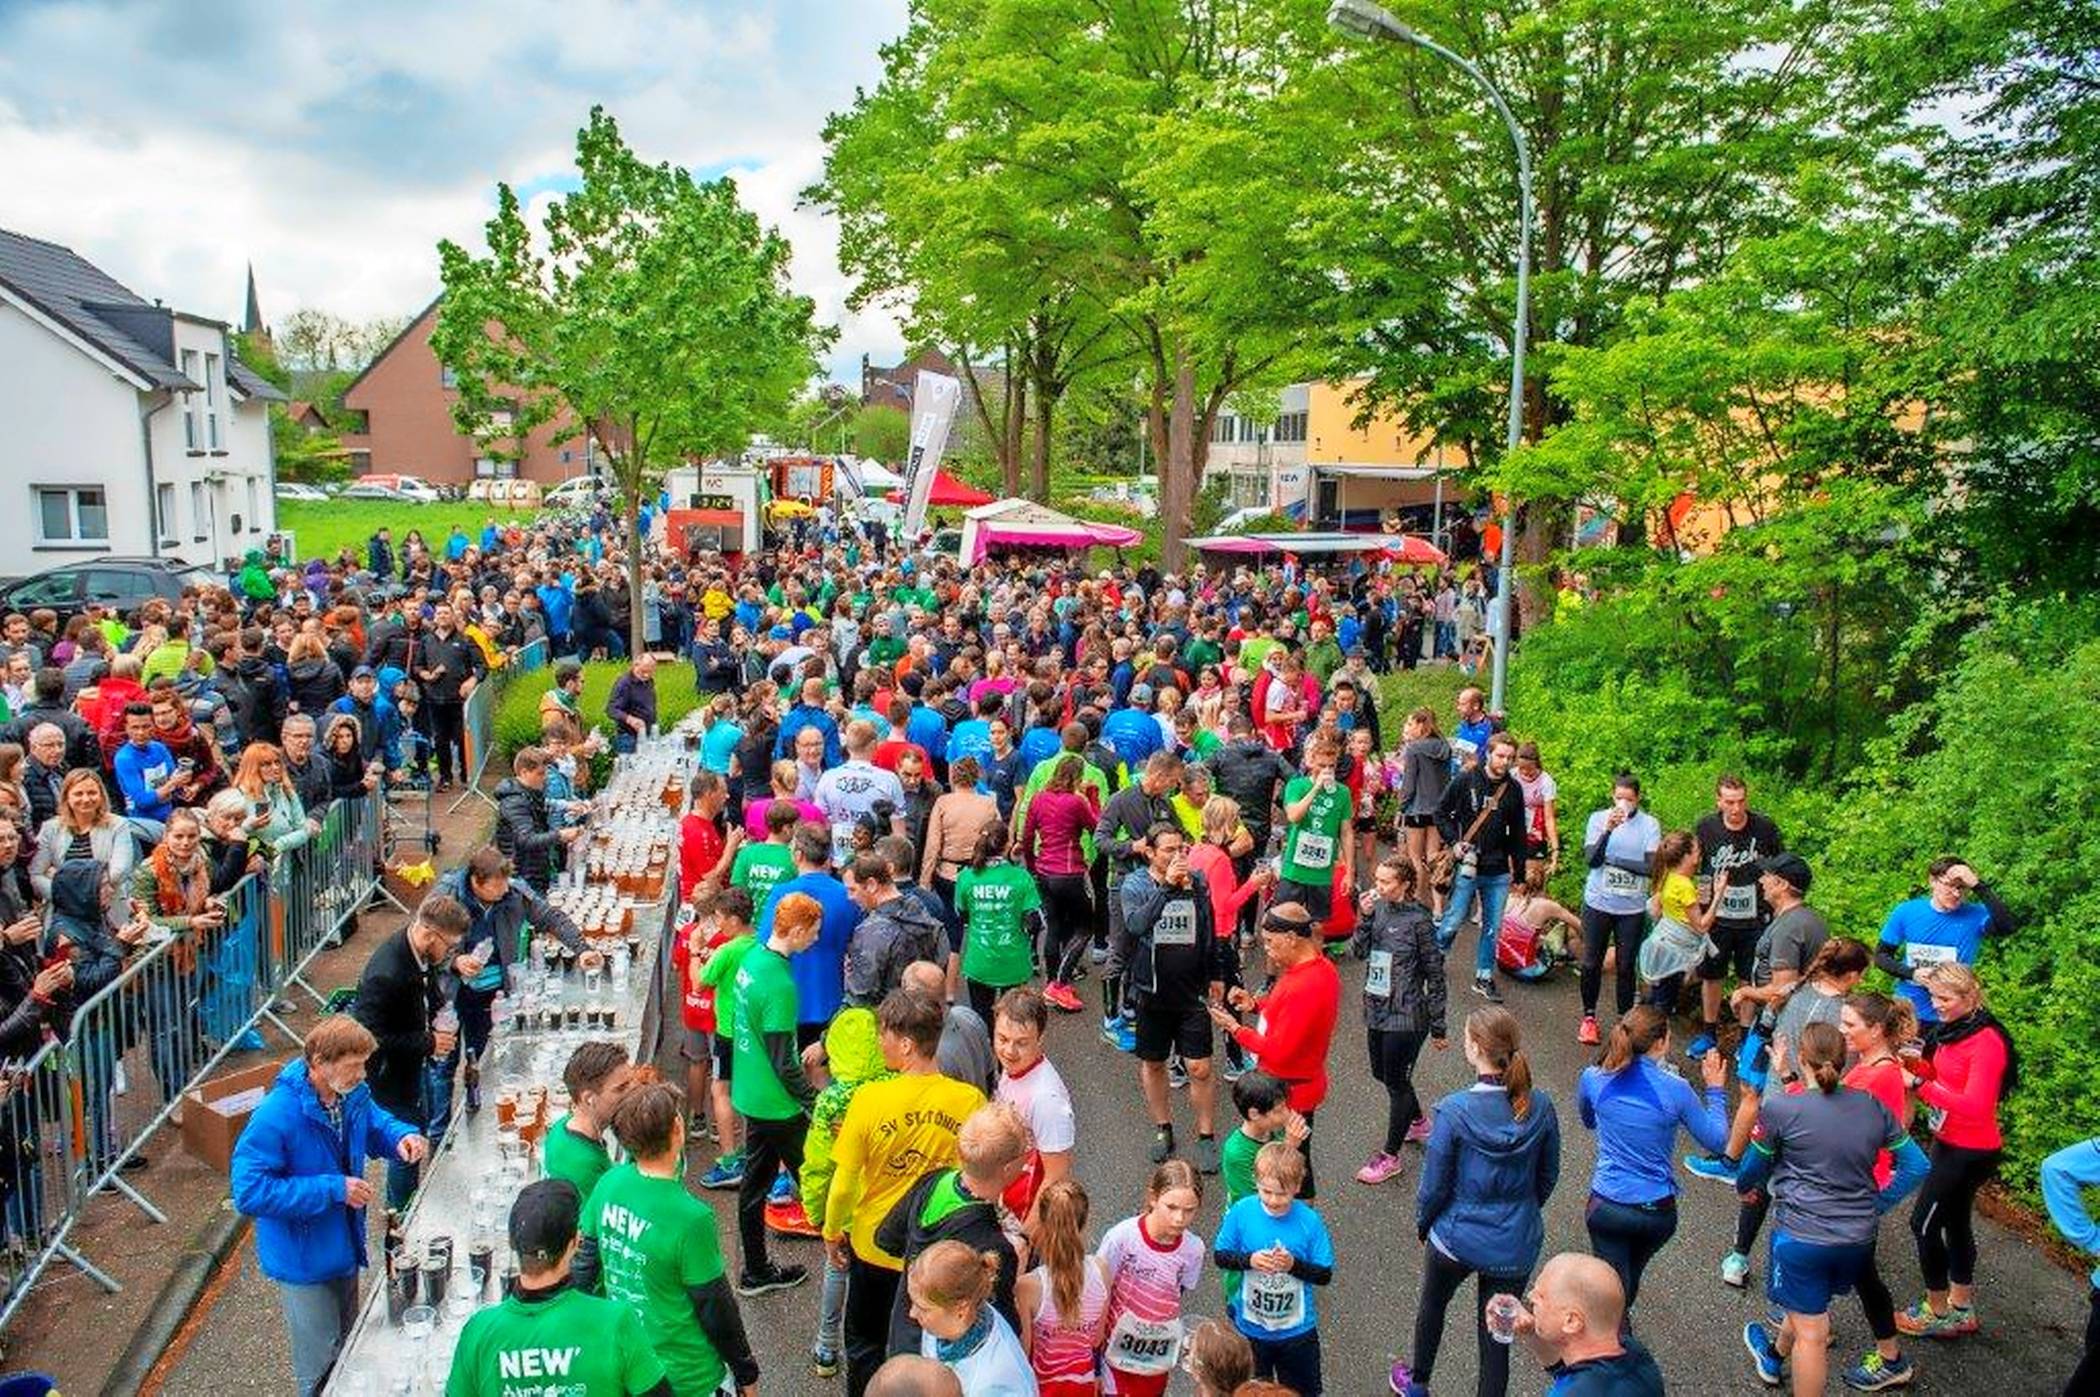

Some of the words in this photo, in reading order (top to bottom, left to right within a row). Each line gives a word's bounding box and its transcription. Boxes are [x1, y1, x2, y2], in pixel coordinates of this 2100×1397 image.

[879, 1118, 897, 1138] SV
[1252, 1288, 1295, 1313] 3572
[1119, 1333, 1170, 1357] 3043
